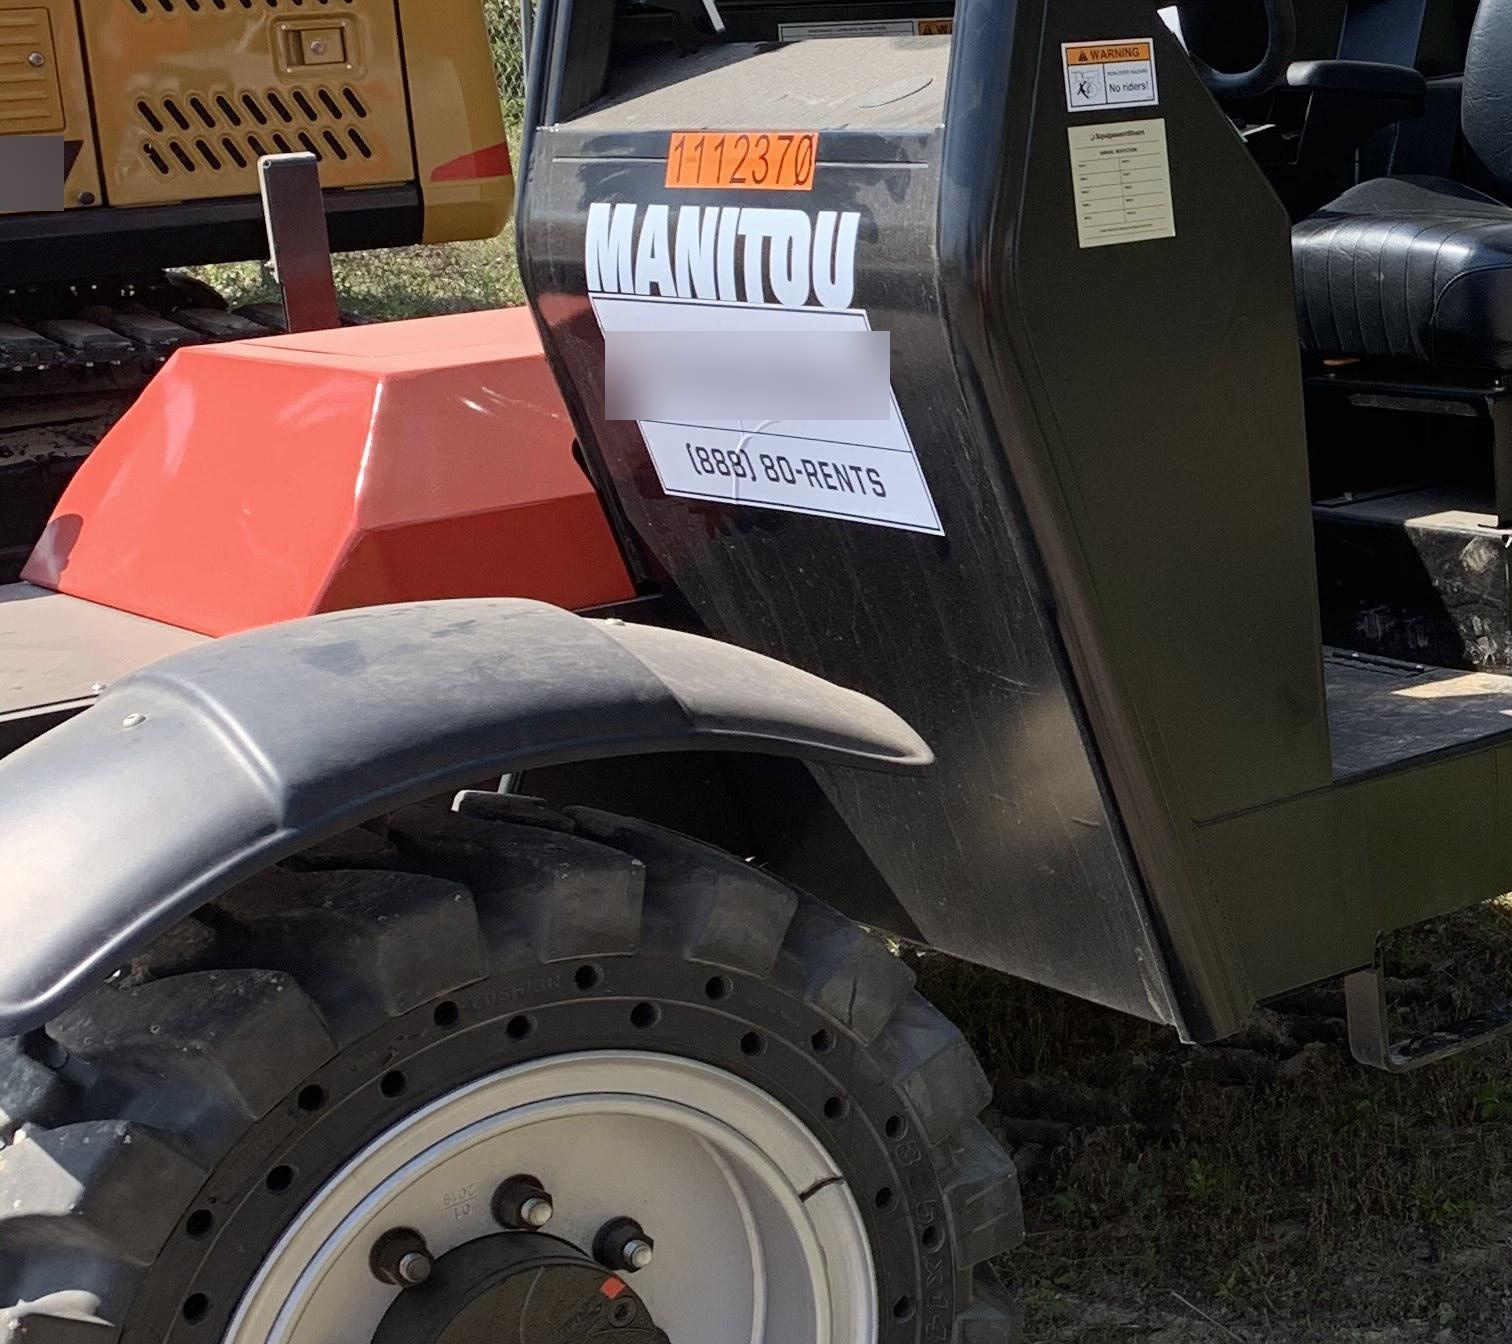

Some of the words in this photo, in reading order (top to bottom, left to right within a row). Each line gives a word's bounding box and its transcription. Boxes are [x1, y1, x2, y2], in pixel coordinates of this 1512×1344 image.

[1090, 47, 1140, 60] WARNING
[1109, 83, 1120, 93] No
[1123, 81, 1149, 92] riders!
[673, 133, 816, 186] 1112370
[585, 203, 860, 309] MANITOU
[685, 442, 757, 482] (888)
[759, 454, 887, 498] 80-RENTS
